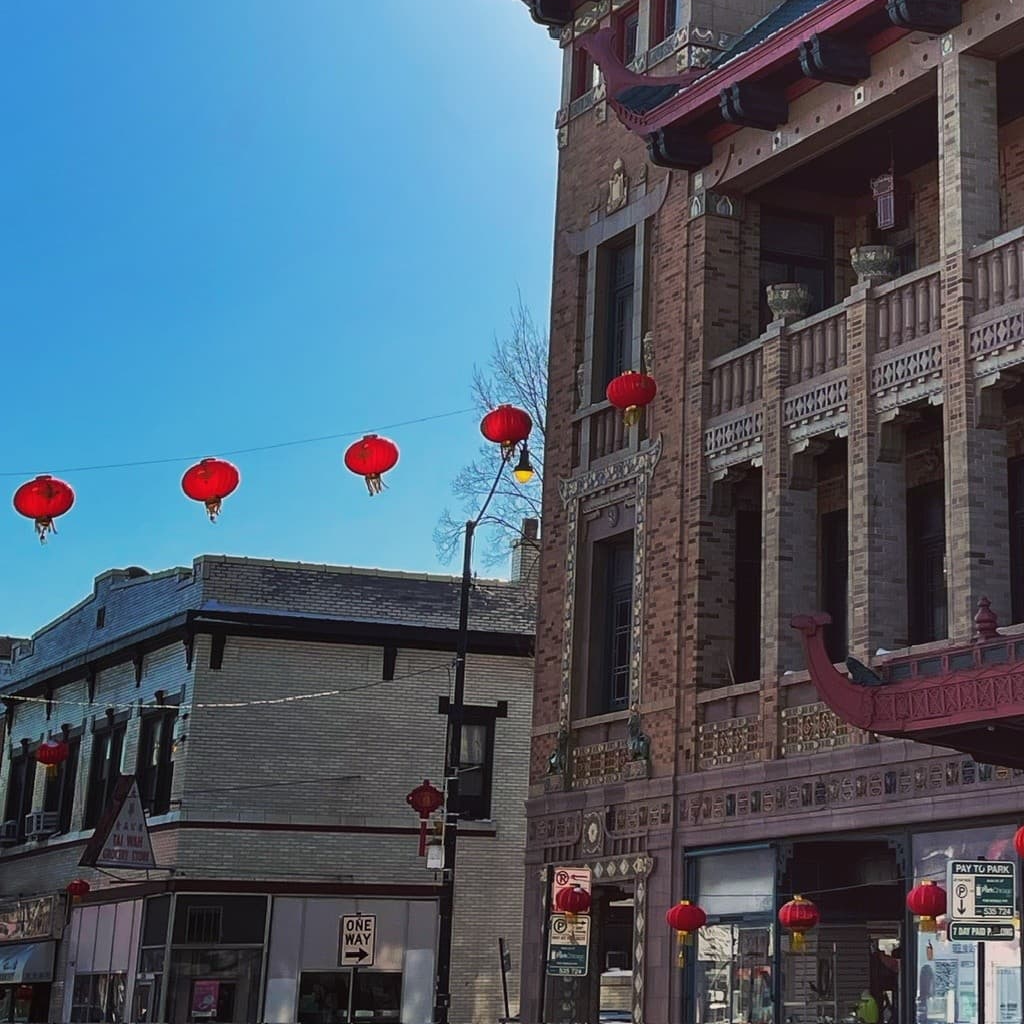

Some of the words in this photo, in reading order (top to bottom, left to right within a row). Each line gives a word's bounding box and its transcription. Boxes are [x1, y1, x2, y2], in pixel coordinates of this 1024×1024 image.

[955, 864, 972, 873] PAY
[973, 864, 986, 873] TO
[986, 865, 1010, 874] PARK
[998, 907, 1011, 915] 724
[346, 919, 372, 931] ONE
[345, 933, 371, 945] WAY
